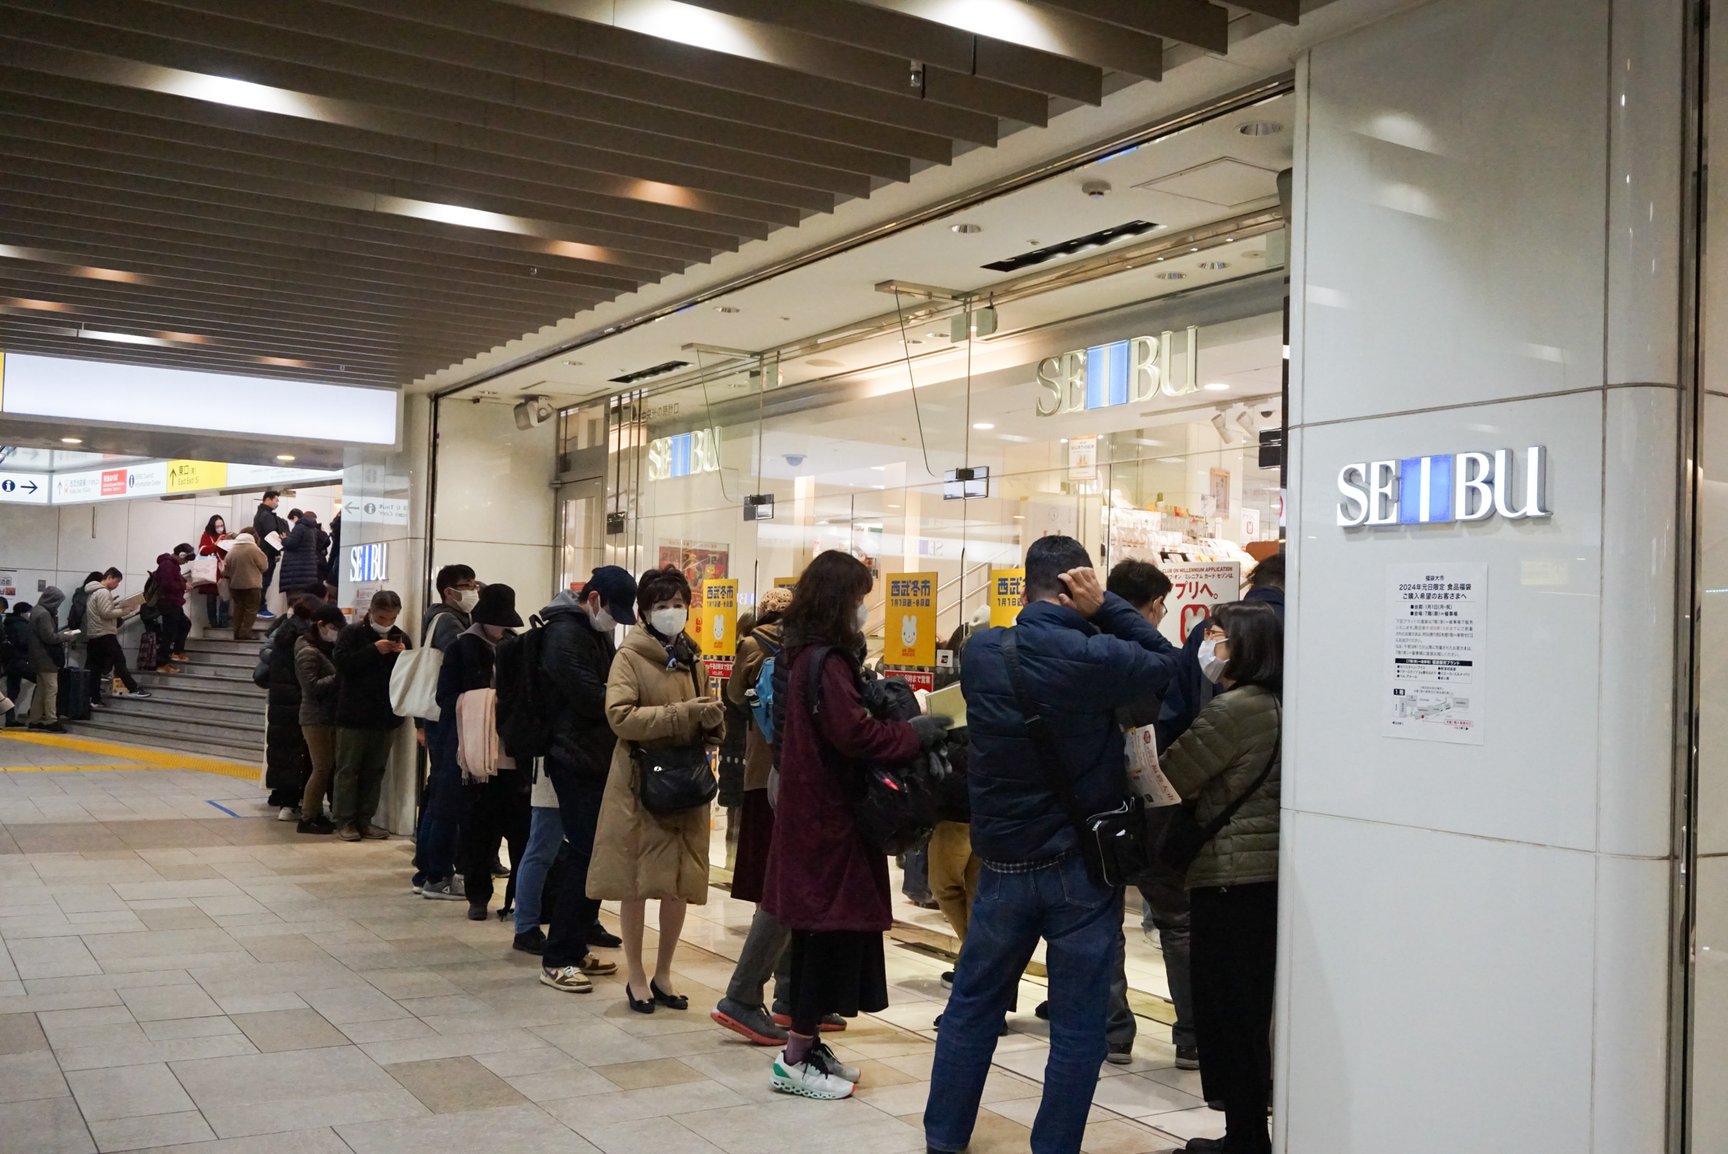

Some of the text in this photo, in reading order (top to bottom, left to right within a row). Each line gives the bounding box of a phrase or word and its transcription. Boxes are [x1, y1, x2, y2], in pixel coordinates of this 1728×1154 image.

[1036, 325, 1200, 417] SEIBU
[648, 426, 722, 481] SEIBU
[1336, 445, 1553, 528] SEIBU
[350, 543, 389, 582] SEIBU
[707, 585, 735, 599] 西武冬市
[891, 579, 931, 597] 西武冬市
[997, 576, 1026, 595] 西武
[1399, 583, 1472, 591] 2024年元日限定 食品福袋
[1403, 592, 1467, 600] ご購入希望のお客さまへ
